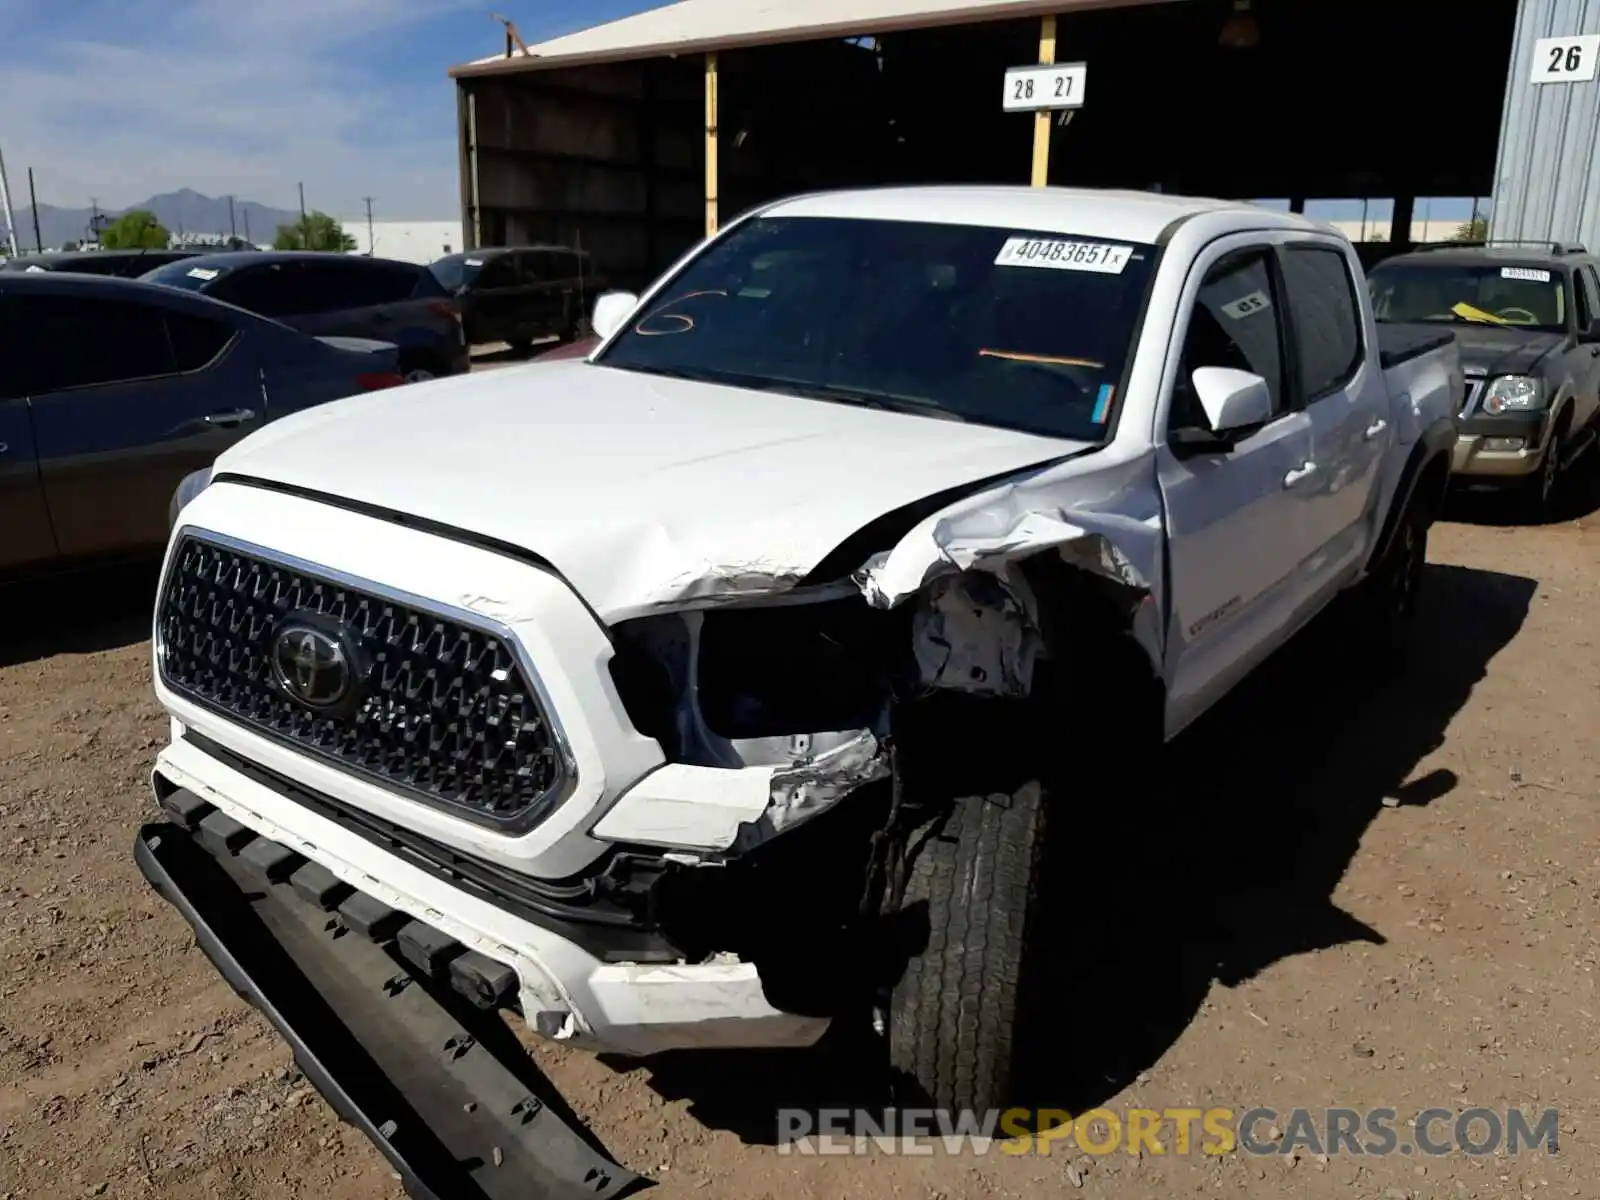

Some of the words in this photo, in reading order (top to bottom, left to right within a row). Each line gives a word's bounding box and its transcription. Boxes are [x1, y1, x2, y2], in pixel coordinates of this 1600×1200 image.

[1547, 45, 1582, 72] 26
[1014, 79, 1034, 99] 28
[1054, 76, 1073, 97] 27
